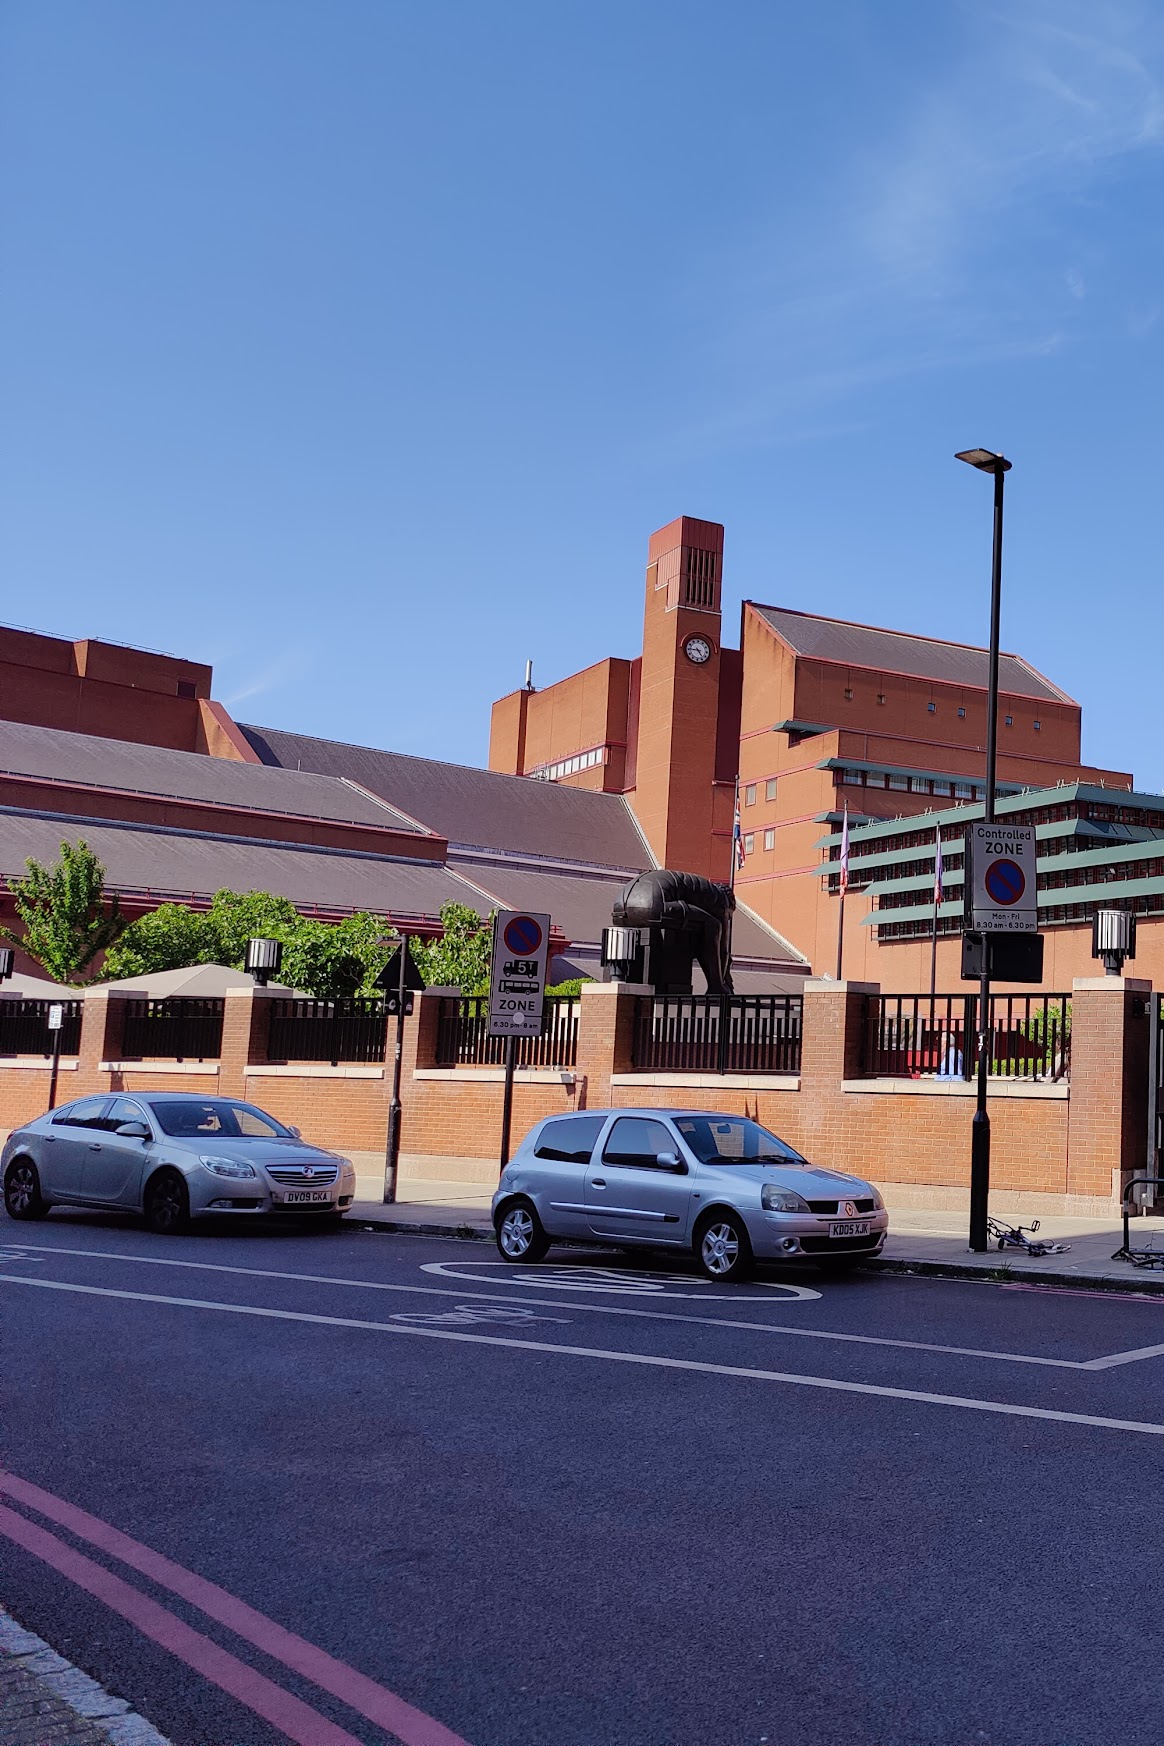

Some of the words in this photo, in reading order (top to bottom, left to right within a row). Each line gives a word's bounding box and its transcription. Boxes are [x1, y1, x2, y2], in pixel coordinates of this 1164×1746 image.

[977, 828, 1031, 840] Controlled
[985, 842, 1023, 855] ZONE
[992, 912, 1006, 920] Mon
[499, 999, 536, 1011] ZONE
[288, 1192, 311, 1201] DV09
[312, 1192, 327, 1201] GKA
[833, 1225, 854, 1235] KD05
[855, 1223, 868, 1234] XJK
